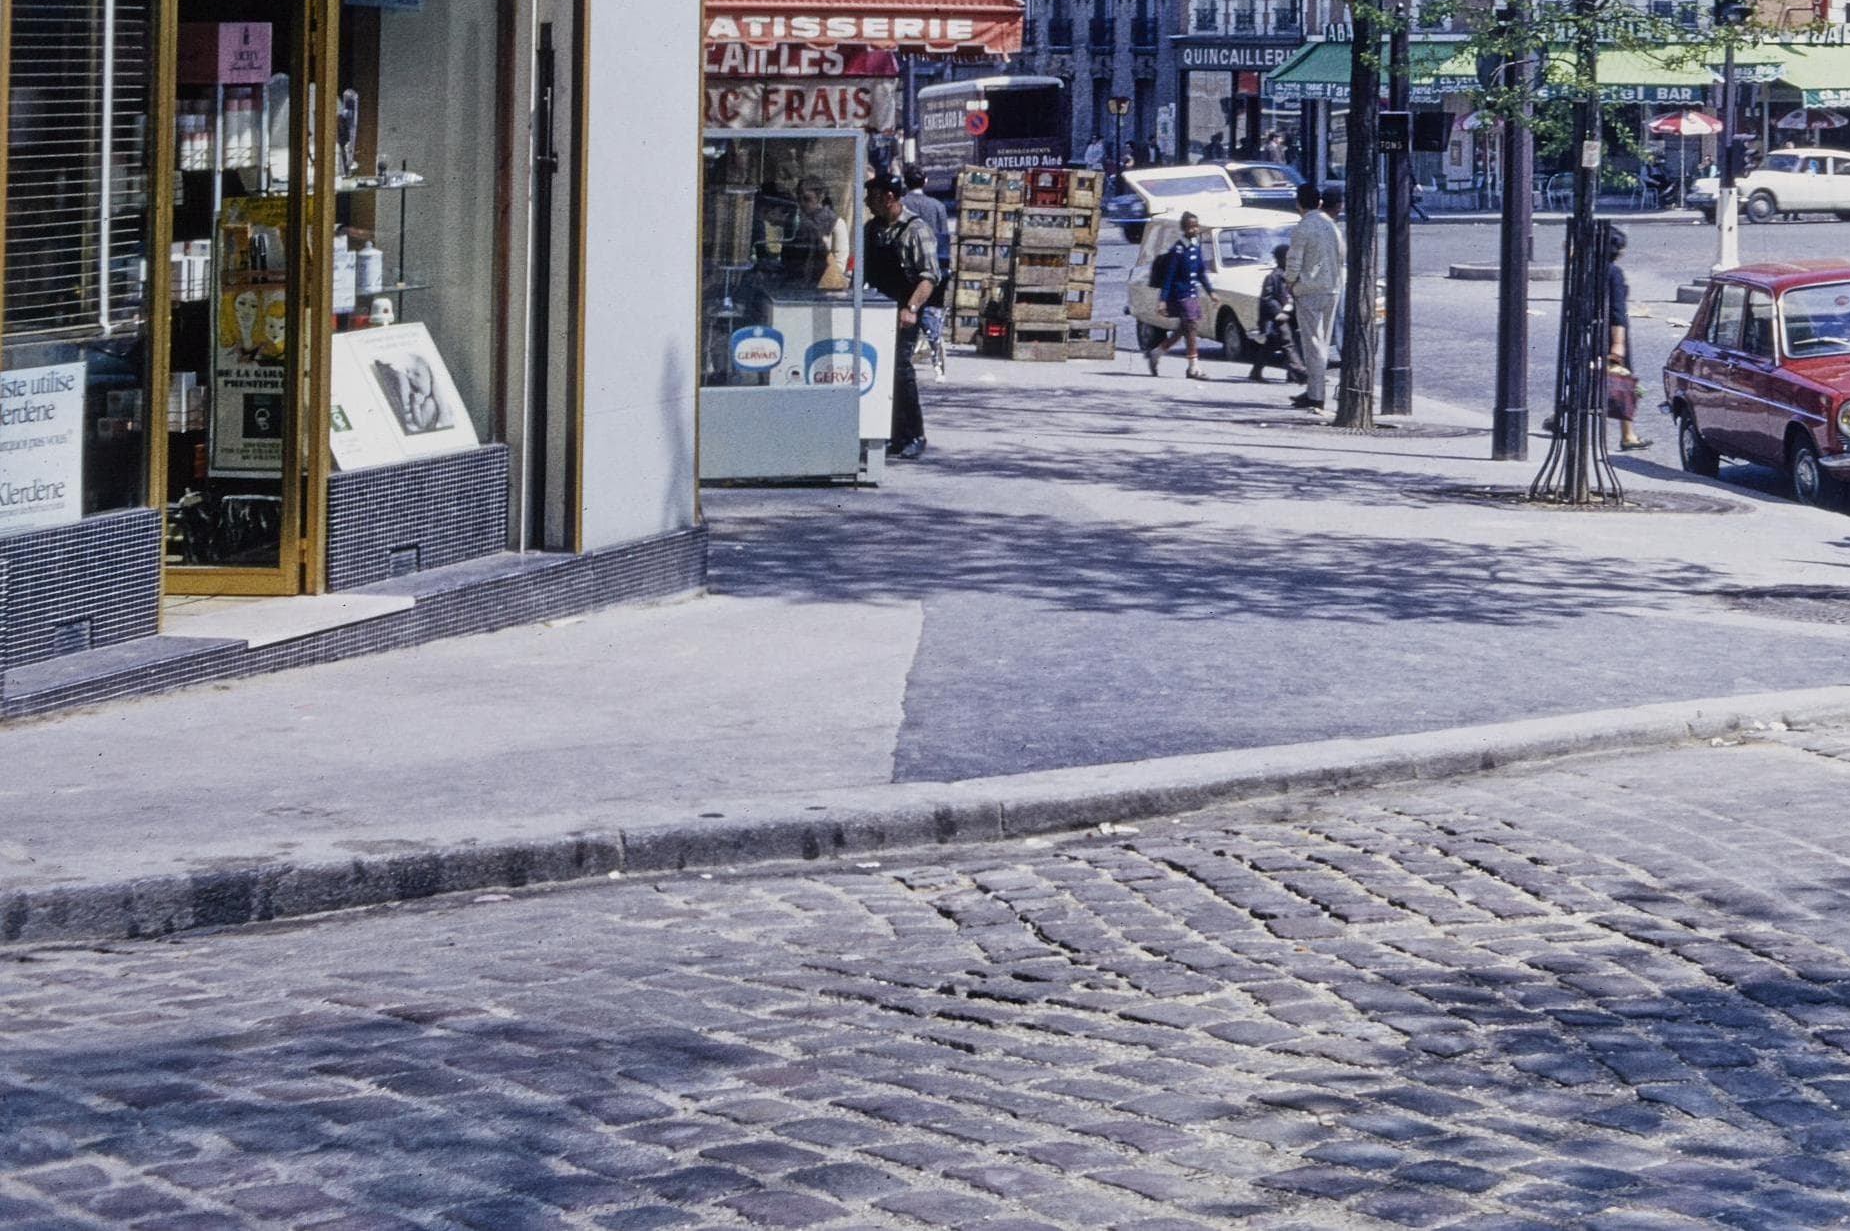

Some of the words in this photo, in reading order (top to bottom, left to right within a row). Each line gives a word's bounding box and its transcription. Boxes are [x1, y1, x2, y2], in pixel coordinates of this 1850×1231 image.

[707, 16, 972, 40] ATISSERIE
[1322, 23, 1354, 42] TABA
[703, 42, 846, 75] LAILLES
[1183, 48, 1297, 66] QUINCAILLERI
[1656, 87, 1693, 100] BAR
[762, 86, 873, 123] FRAIS
[985, 156, 1039, 168] CHATELARD
[737, 351, 778, 360] GERVAIS
[0, 379, 27, 399] iste
[31, 371, 75, 395] utilise
[813, 370, 868, 384] GERVAS
